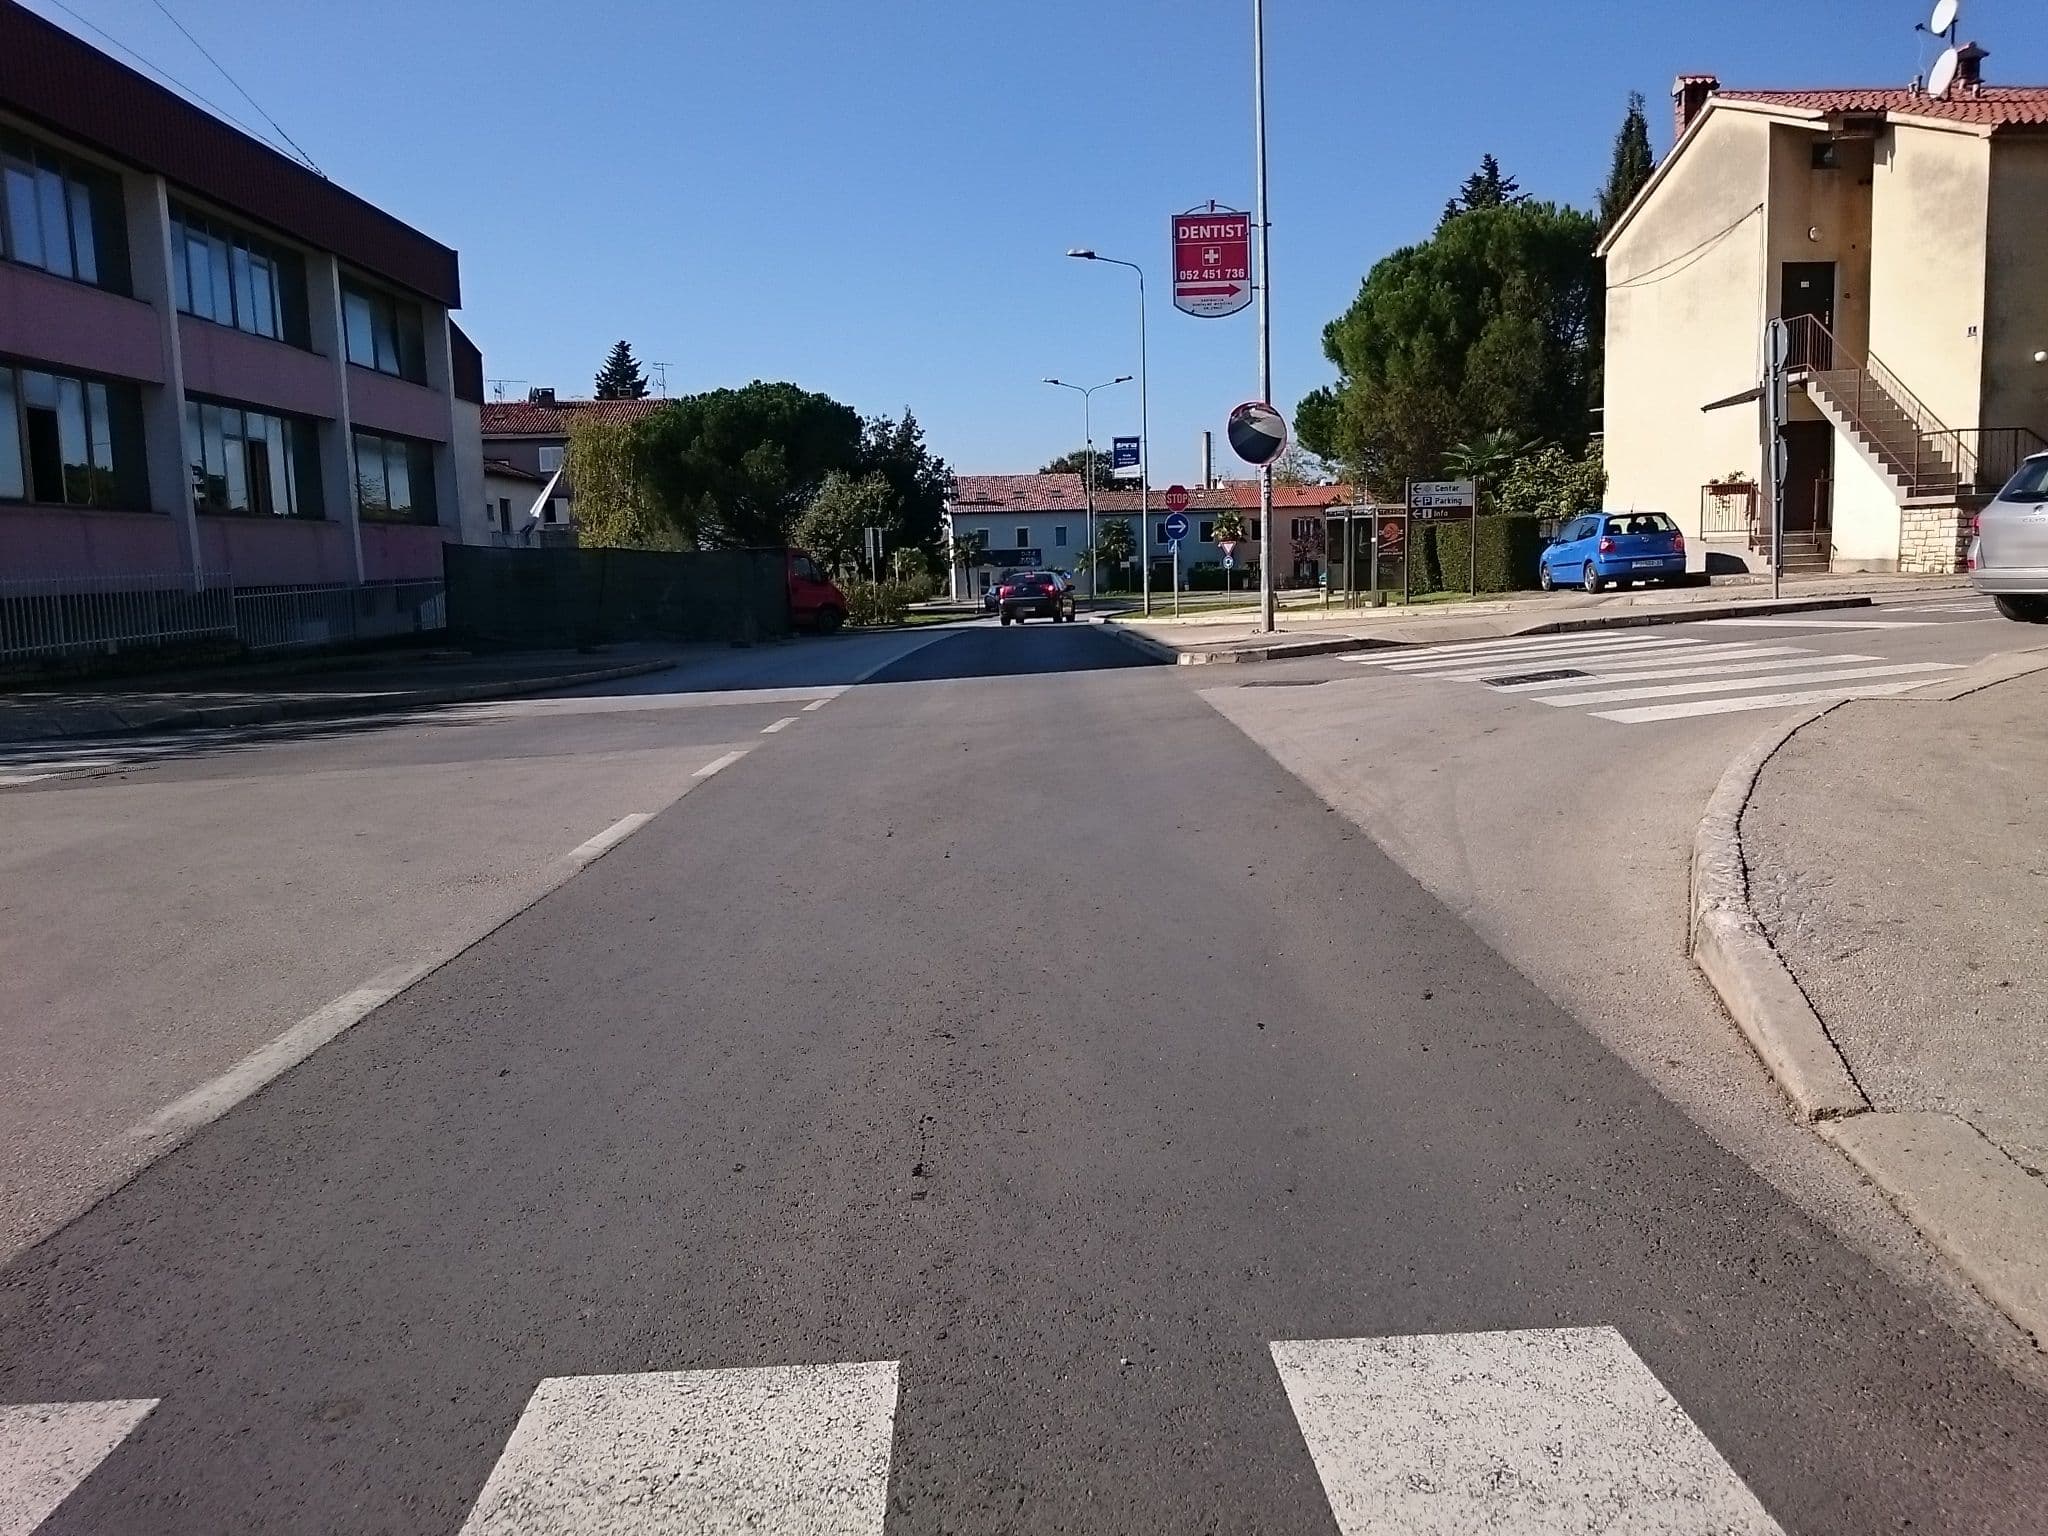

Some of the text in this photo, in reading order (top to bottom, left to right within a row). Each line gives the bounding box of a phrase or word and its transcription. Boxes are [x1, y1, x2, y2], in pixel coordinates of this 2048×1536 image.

[1178, 224, 1245, 239] DENTIST
[1179, 268, 1245, 280] 052 451 736
[1166, 493, 1188, 504] STOP
[1434, 497, 1463, 505] Parking
[1433, 509, 1449, 517] Info
